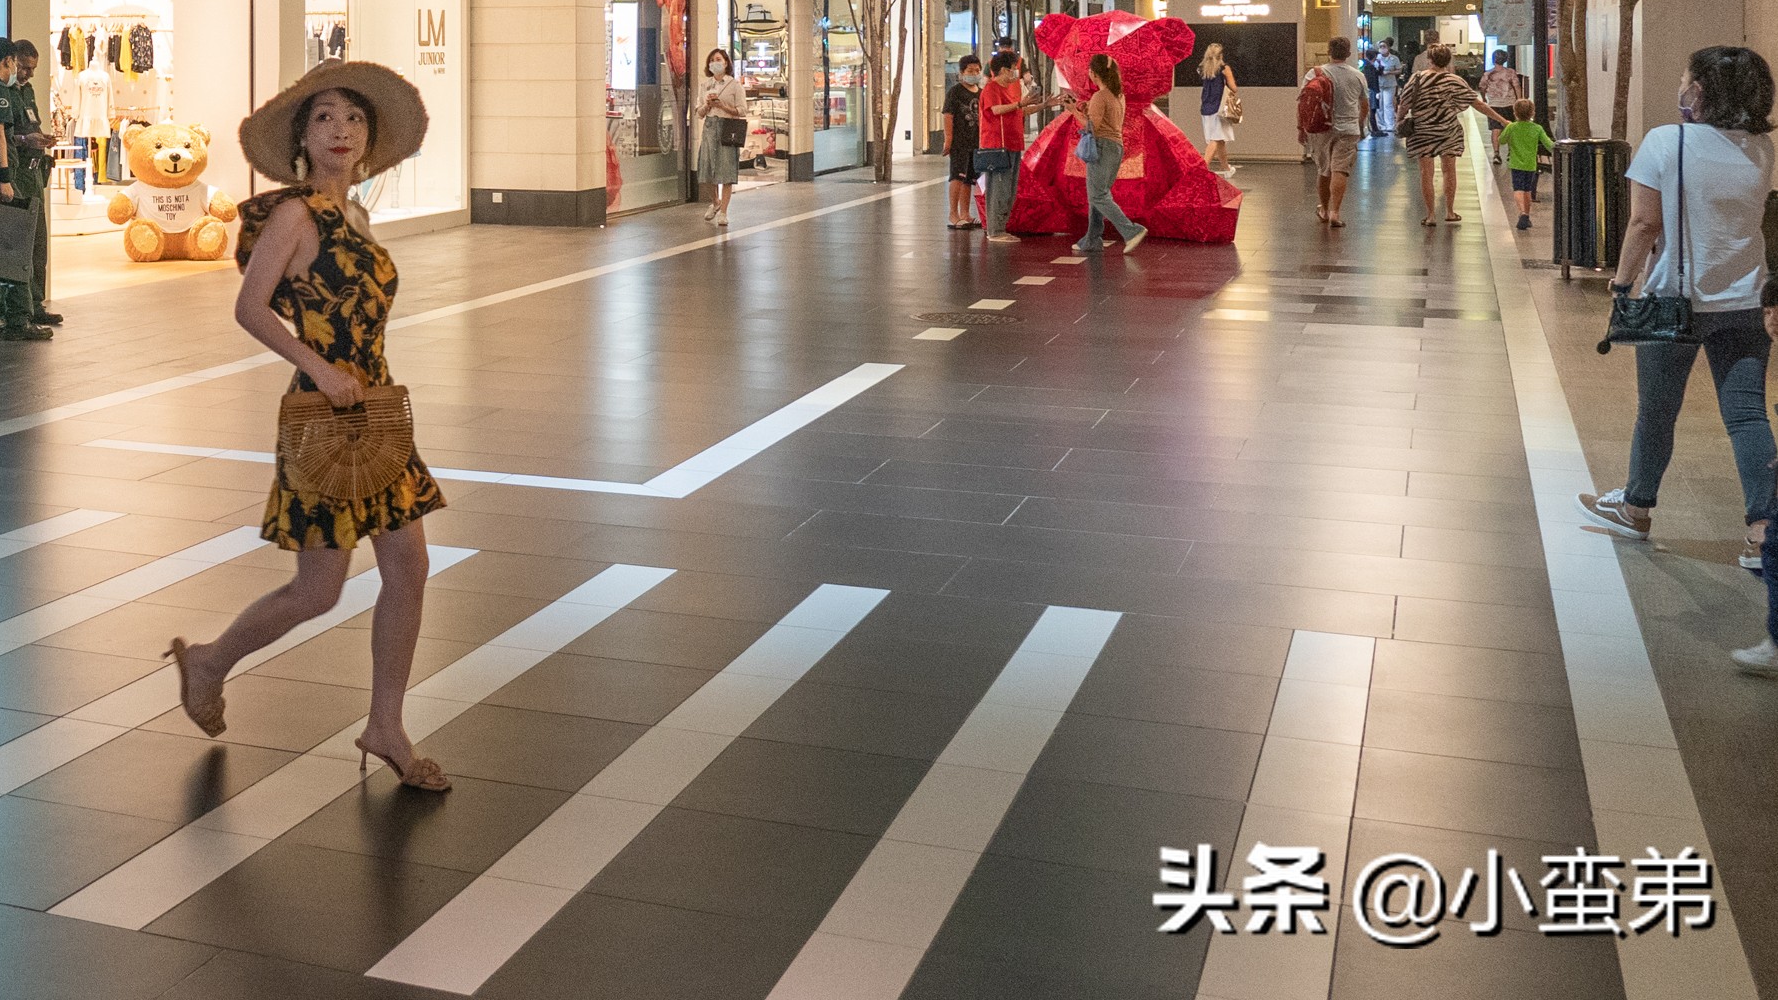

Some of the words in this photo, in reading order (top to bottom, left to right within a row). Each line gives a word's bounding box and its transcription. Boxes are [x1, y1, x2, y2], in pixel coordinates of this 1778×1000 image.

[418, 9, 445, 46] LM
[418, 52, 445, 66] JUNIOR
[152, 195, 164, 203] THIS
[166, 195, 172, 203] IS
[175, 195, 185, 203] NOT
[158, 203, 185, 212] MOSCHINO
[166, 212, 176, 220] TOY
